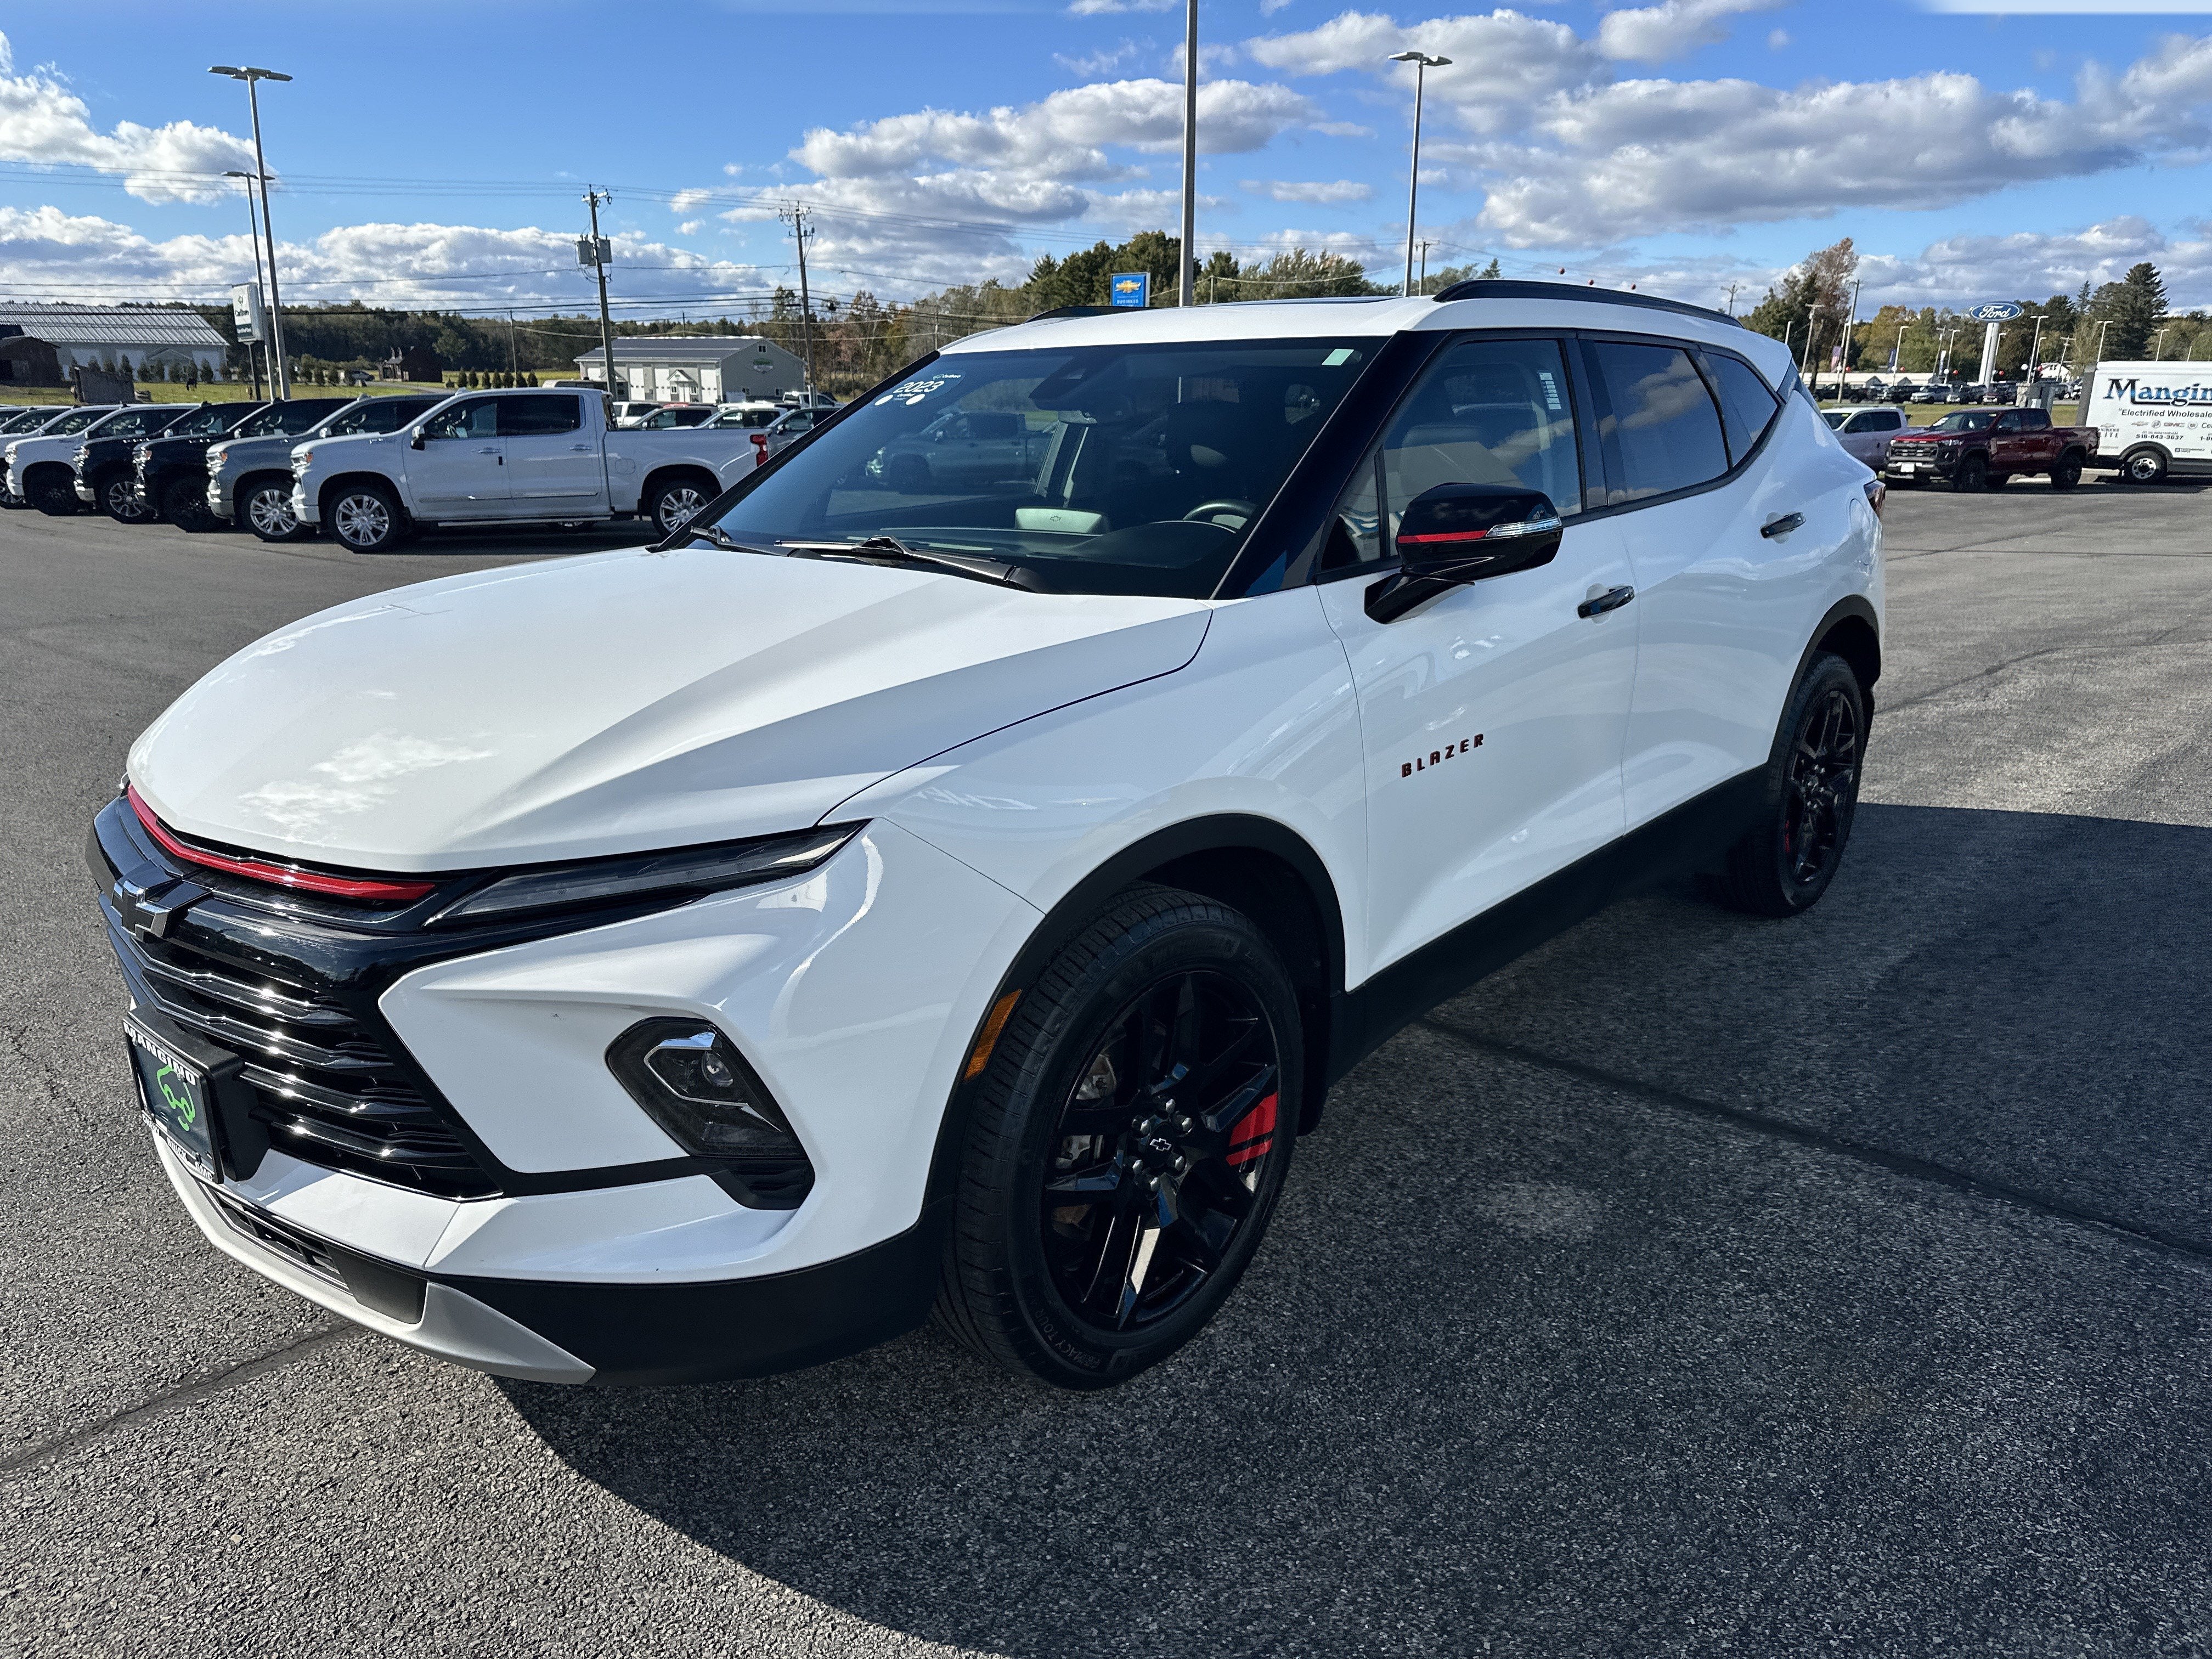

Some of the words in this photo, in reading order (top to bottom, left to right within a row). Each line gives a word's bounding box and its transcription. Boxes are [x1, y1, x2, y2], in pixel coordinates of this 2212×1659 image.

[1979, 305, 2011, 318] Ford
[893, 380, 945, 393] 2023
[1402, 733, 1483, 777] BLAZER
[123, 1022, 196, 1086] MANGINO
[1034, 1308, 1059, 1341] TOUR
